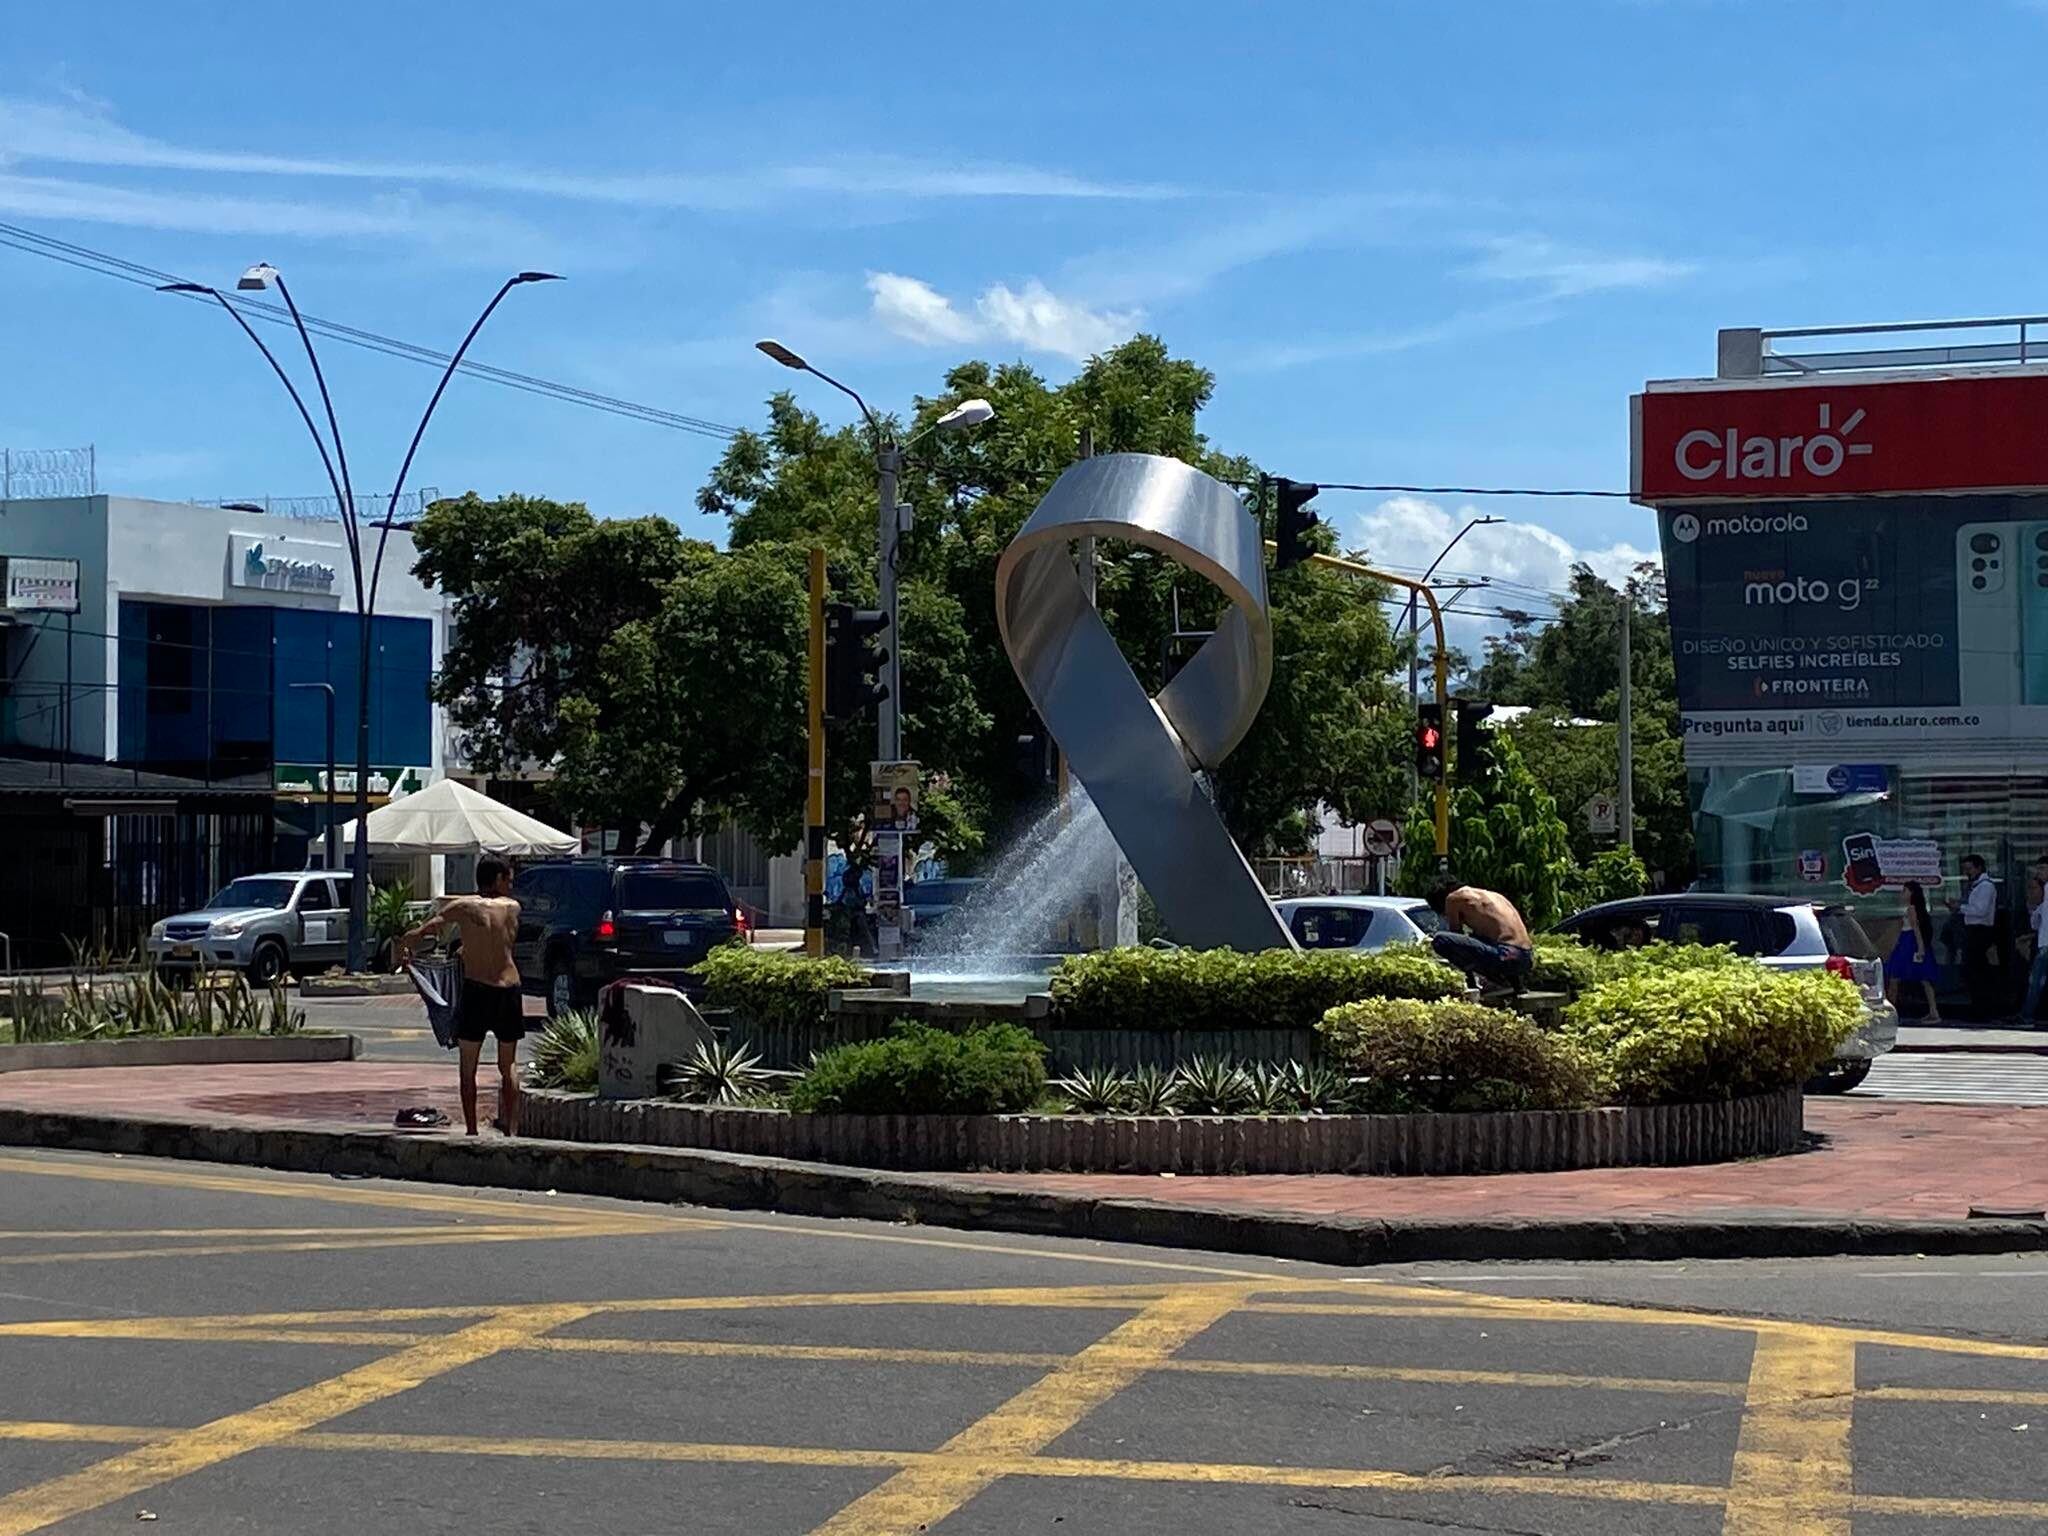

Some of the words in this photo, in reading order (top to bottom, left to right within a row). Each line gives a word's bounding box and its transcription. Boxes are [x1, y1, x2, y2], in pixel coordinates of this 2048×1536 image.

[1674, 428, 1845, 480] Claro
[1707, 512, 1808, 535] motorola
[1745, 576, 1830, 605] moto
[1682, 636, 1746, 654] DISEÑO
[1806, 637, 1821, 650] Y
[1825, 633, 1944, 650] SOFISTICADO
[1727, 655, 1794, 670] SELFIES
[1799, 651, 1902, 669] INCREÍBLES
[1772, 678, 1869, 694] FRONTERA
[1682, 717, 1763, 737] Pregunta
[1846, 714, 1980, 728] tienda.claro.com.co
[1850, 847, 1874, 861] Sin
